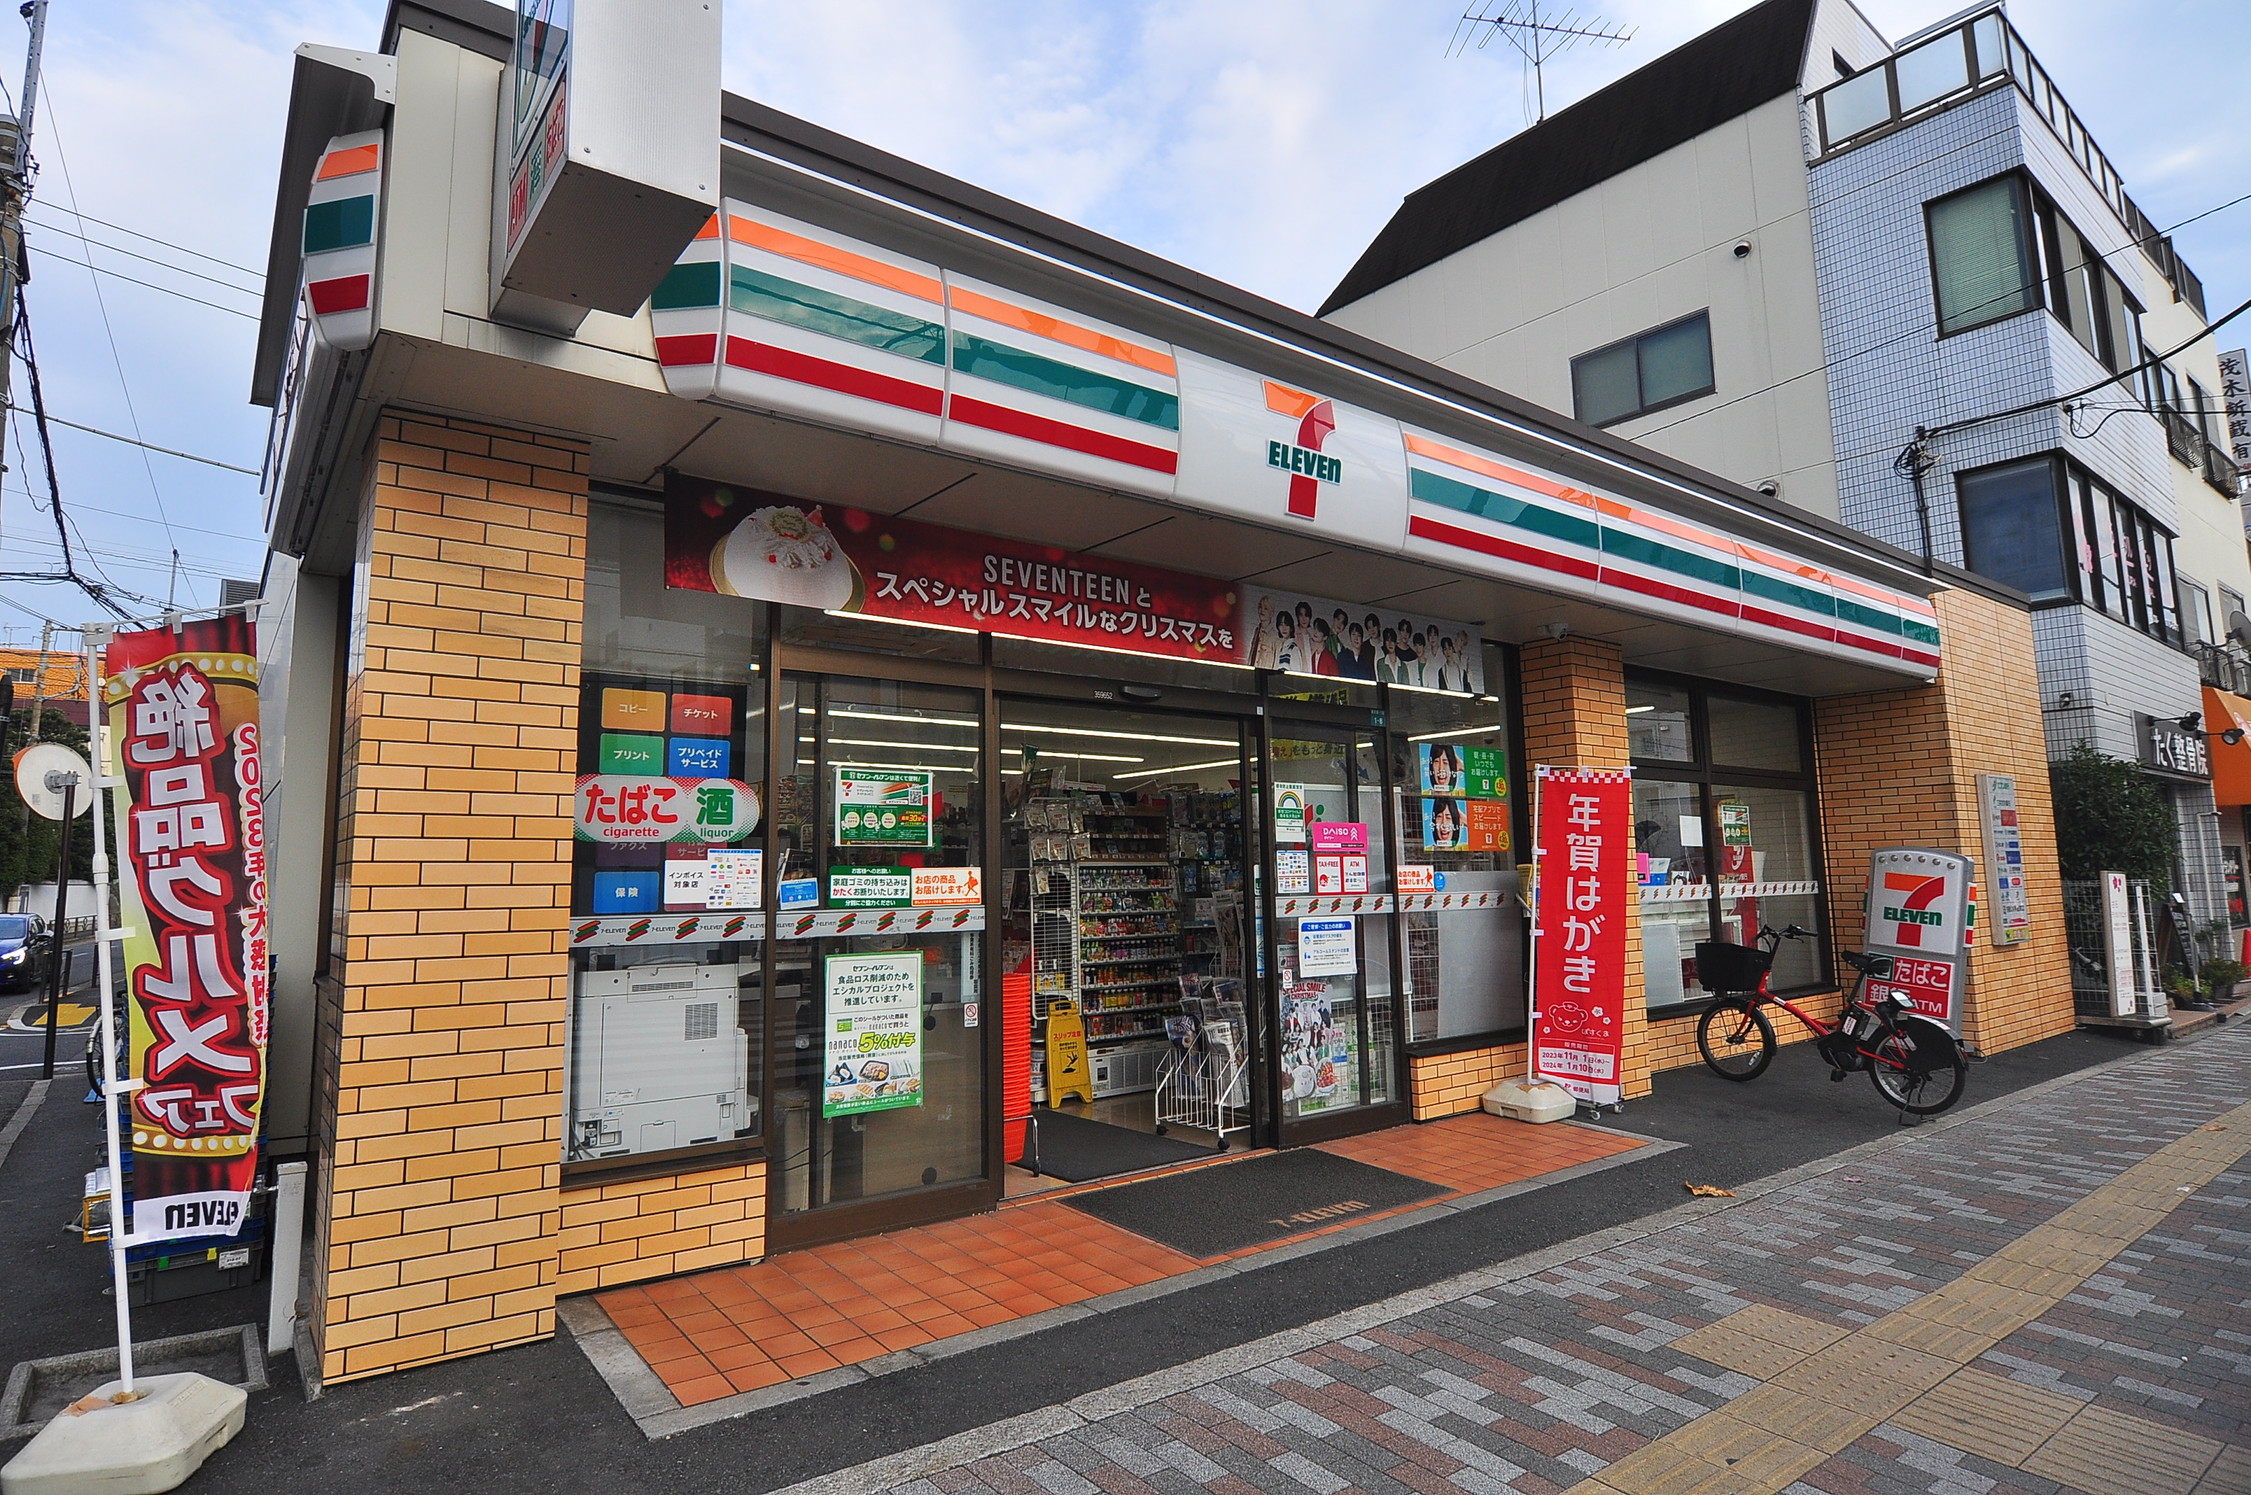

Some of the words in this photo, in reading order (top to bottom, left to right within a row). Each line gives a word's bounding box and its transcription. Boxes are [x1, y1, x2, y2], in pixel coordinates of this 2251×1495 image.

[876, 571, 1233, 650] スペシャルスマイルなクリスマスを
[618, 703, 648, 714] コピー
[683, 708, 718, 719] チケット
[613, 749, 650, 761] プリント
[2151, 728, 2208, 775] たく整骨院
[680, 758, 718, 769] サービス
[584, 783, 678, 826] たばこ
[695, 786, 735, 827] 酒
[602, 826, 660, 839] cigarette
[700, 827, 735, 839] liquor
[1323, 827, 1349, 836] DAISO
[669, 872, 704, 880] インボイス
[915, 875, 956, 884] お店の商品
[833, 878, 907, 887] 家庭ゴミの持ち込みは
[615, 886, 638, 898] 保険
[833, 888, 908, 897] かたくお断りいたします。
[915, 886, 964, 895] お届けします。
[1563, 793, 1606, 994] 年賀はがき
[838, 973, 910, 984] 食品ロス削減のため
[1895, 960, 1947, 988] たばこ
[832, 982, 915, 996] エシカルプロジェクトを
[1307, 983, 1326, 993] SMILE
[844, 995, 902, 1007] 推進しています。
[1582, 1028, 1609, 1037] ぽすくま
[829, 1038, 857, 1050] nanaco
[858, 1032, 916, 1053] 5%付与
[1542, 1052, 1578, 1061] 2023年11月
